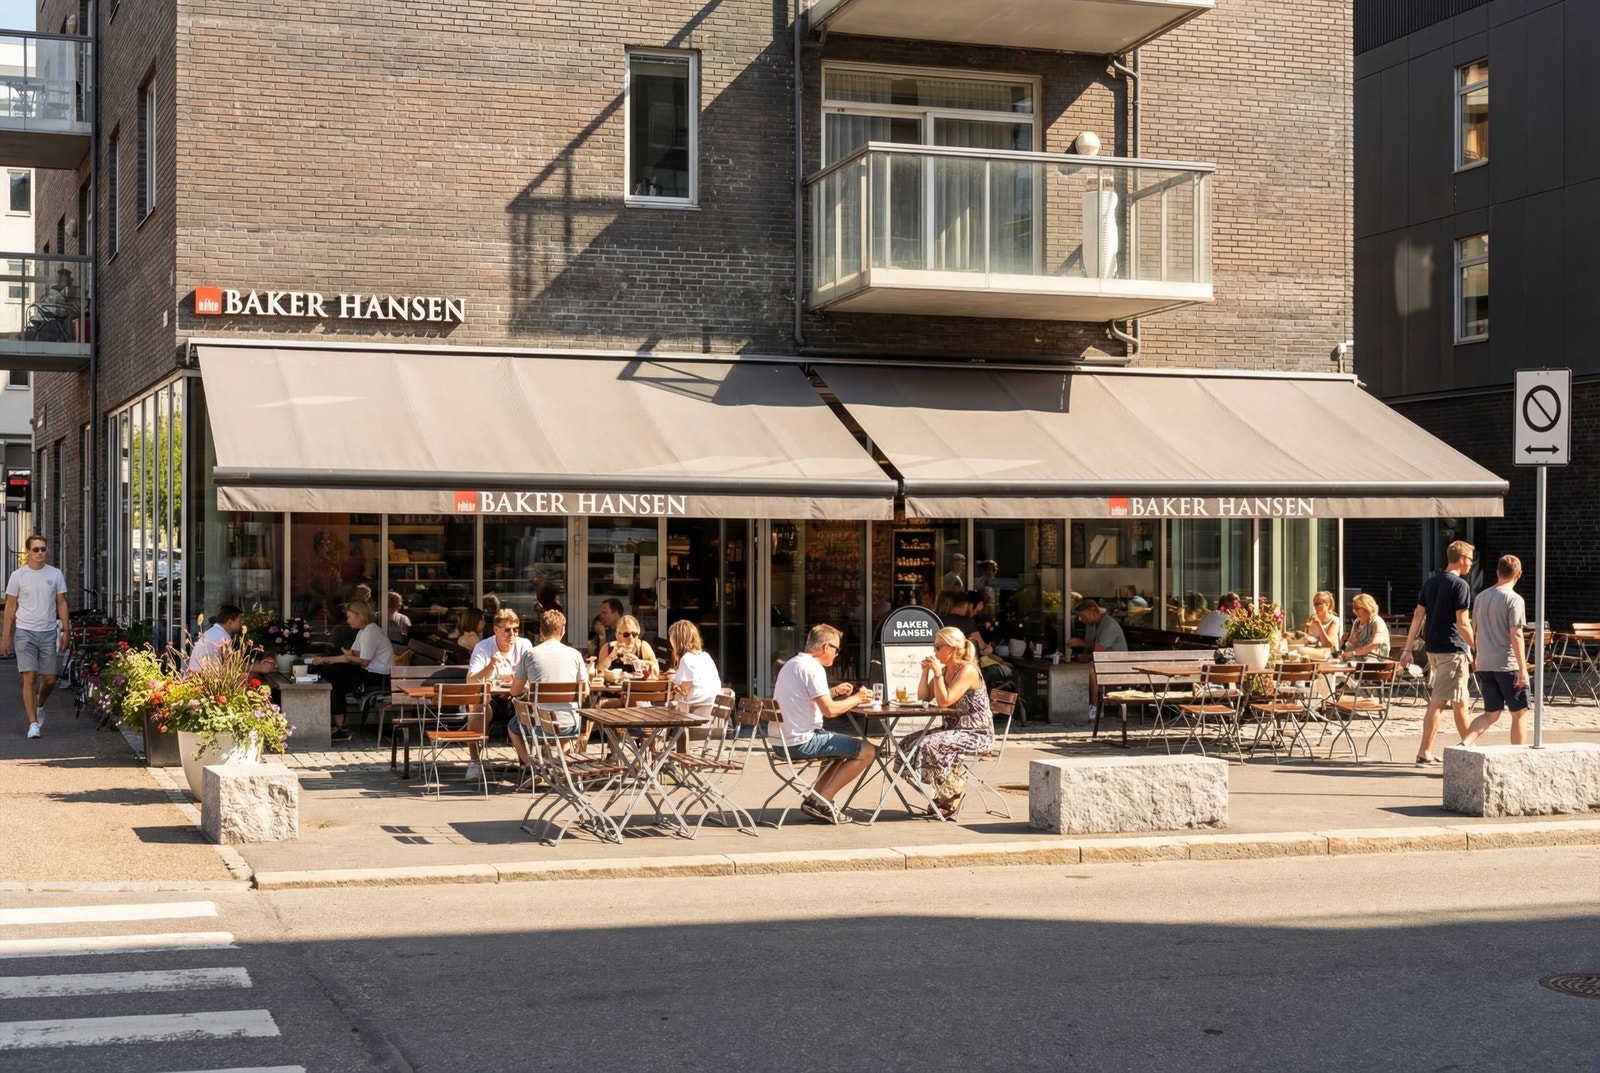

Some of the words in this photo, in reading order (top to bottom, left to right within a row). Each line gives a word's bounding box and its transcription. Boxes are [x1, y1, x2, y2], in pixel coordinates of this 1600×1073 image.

[224, 288, 328, 317] BAKER
[339, 293, 466, 323] HANSEN
[480, 491, 568, 513] BAKER
[577, 493, 687, 515] HANSEN
[1130, 497, 1209, 516] BAKER
[1217, 497, 1315, 516] HANSEN
[893, 629, 933, 637] HANSEN
[896, 621, 929, 629] BAKER
